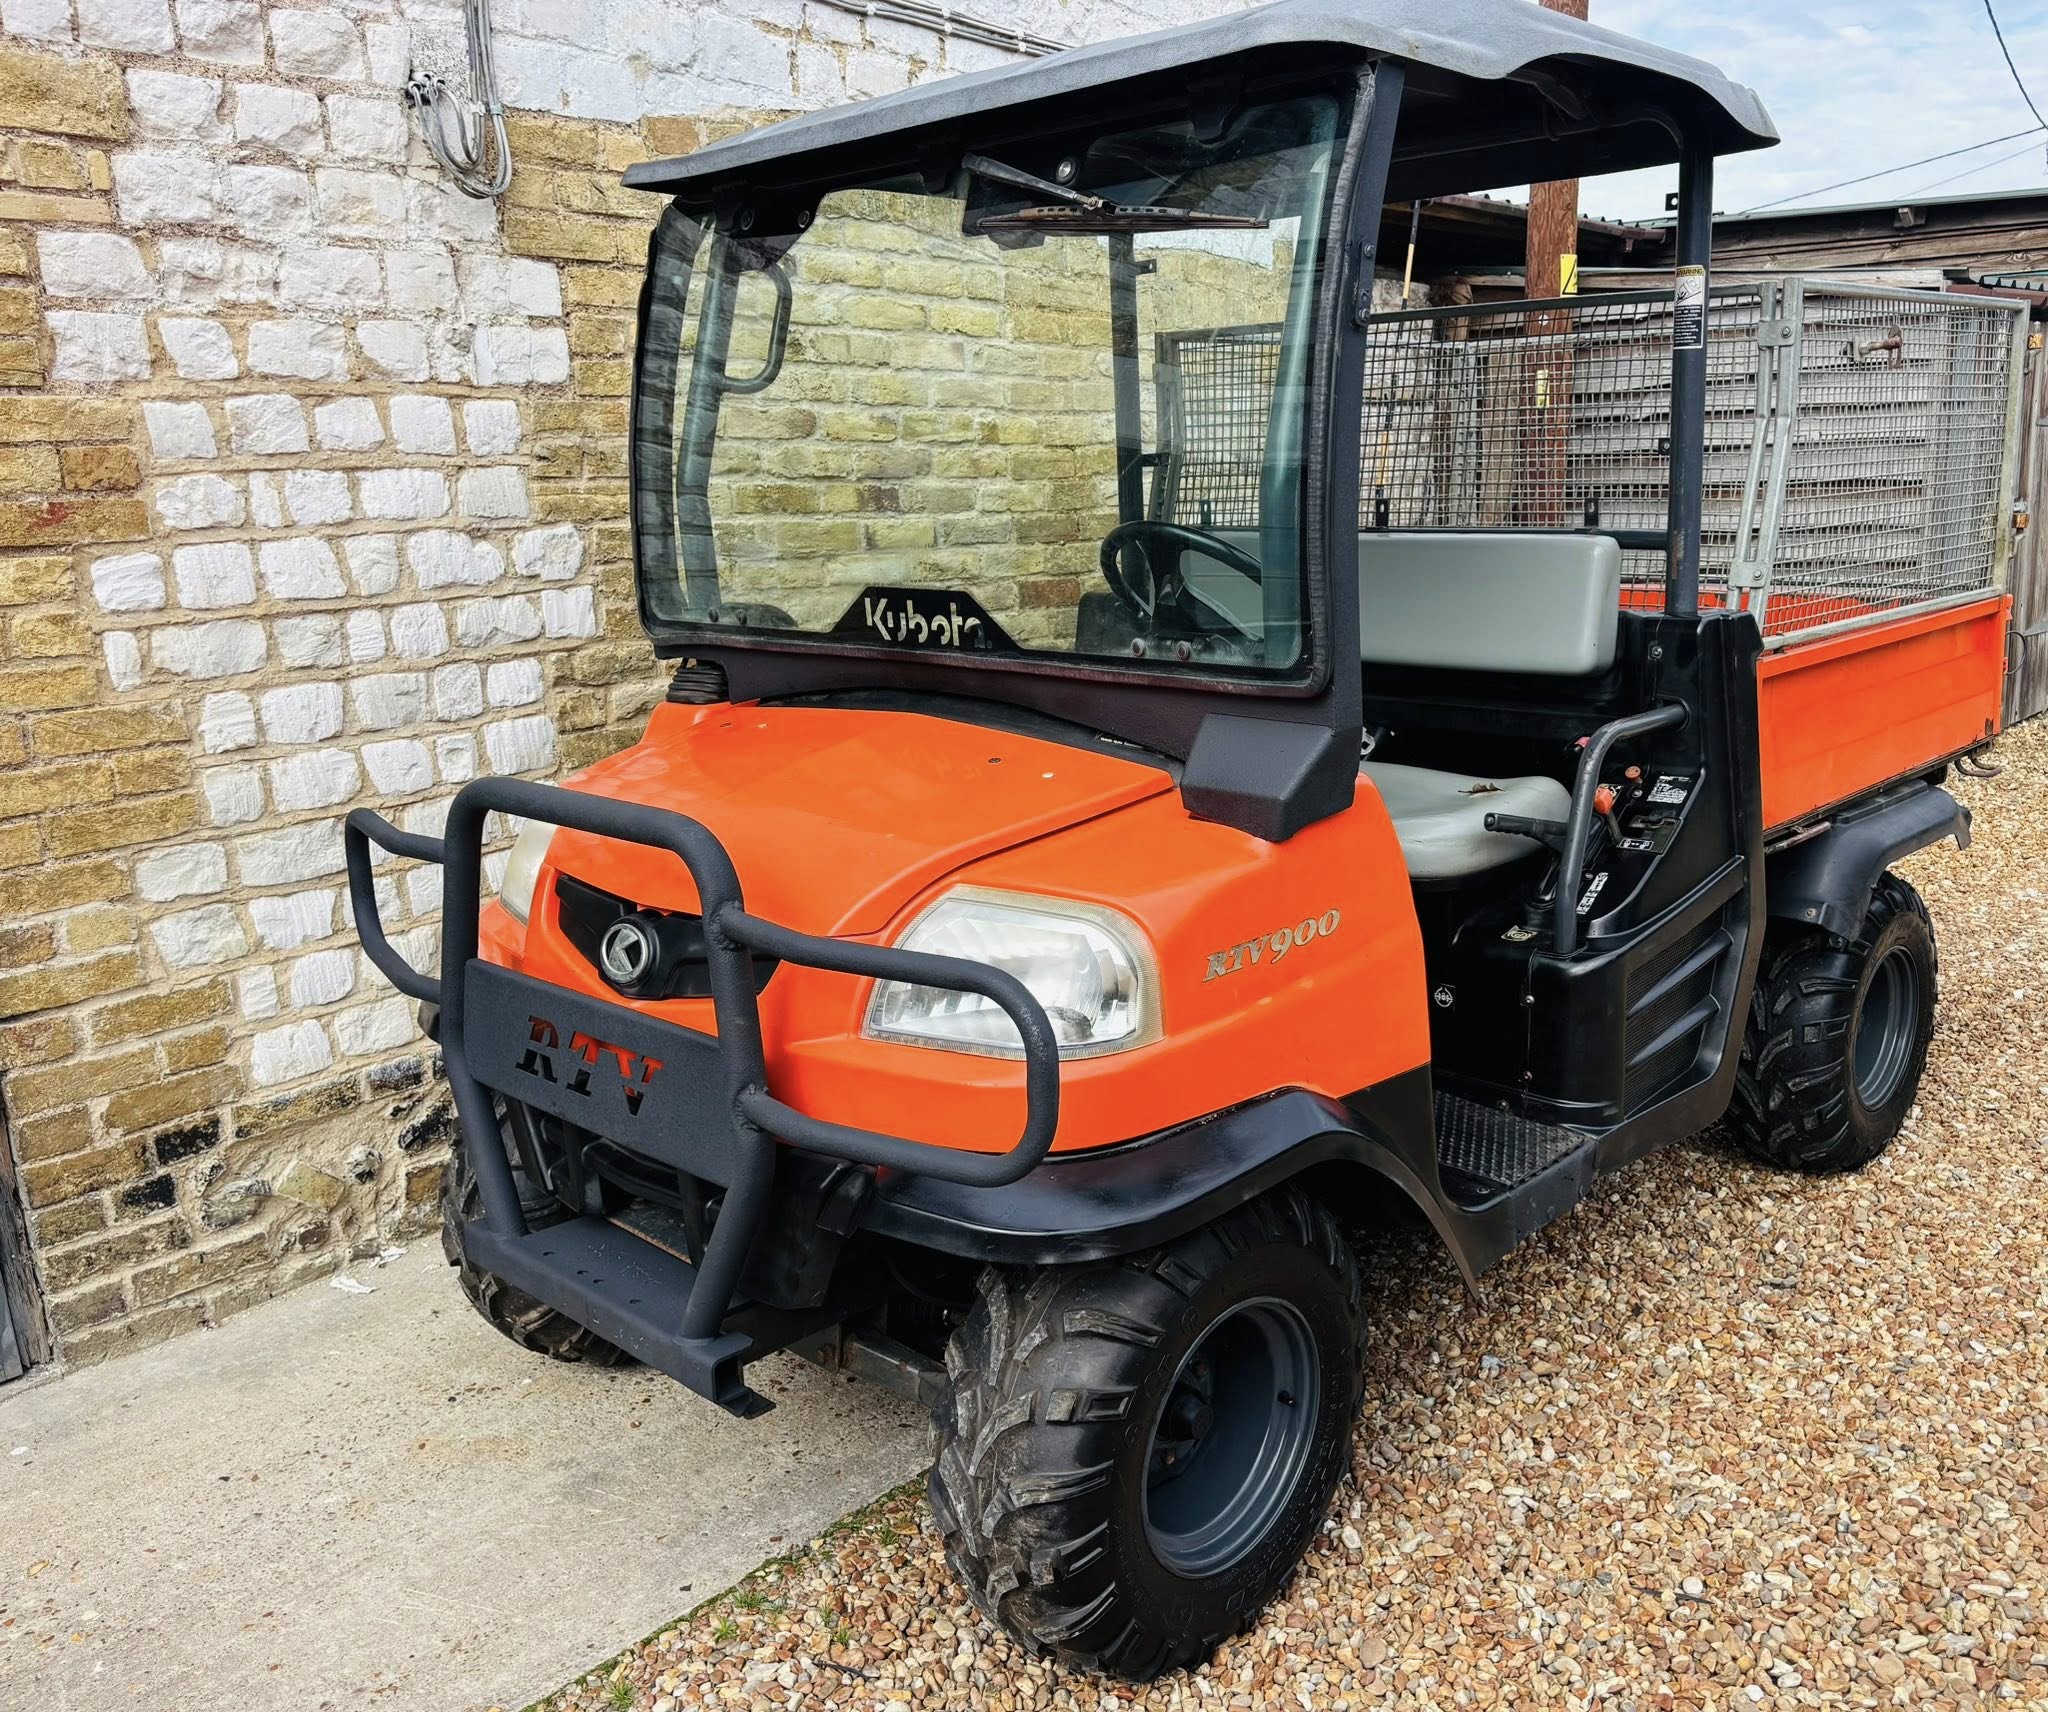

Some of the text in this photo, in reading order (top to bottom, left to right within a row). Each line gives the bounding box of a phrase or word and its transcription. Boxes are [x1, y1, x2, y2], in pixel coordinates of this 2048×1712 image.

[864, 597, 986, 649] Kubota
[1202, 908, 1341, 983] RTV900
[515, 1015, 665, 1117] RTV
